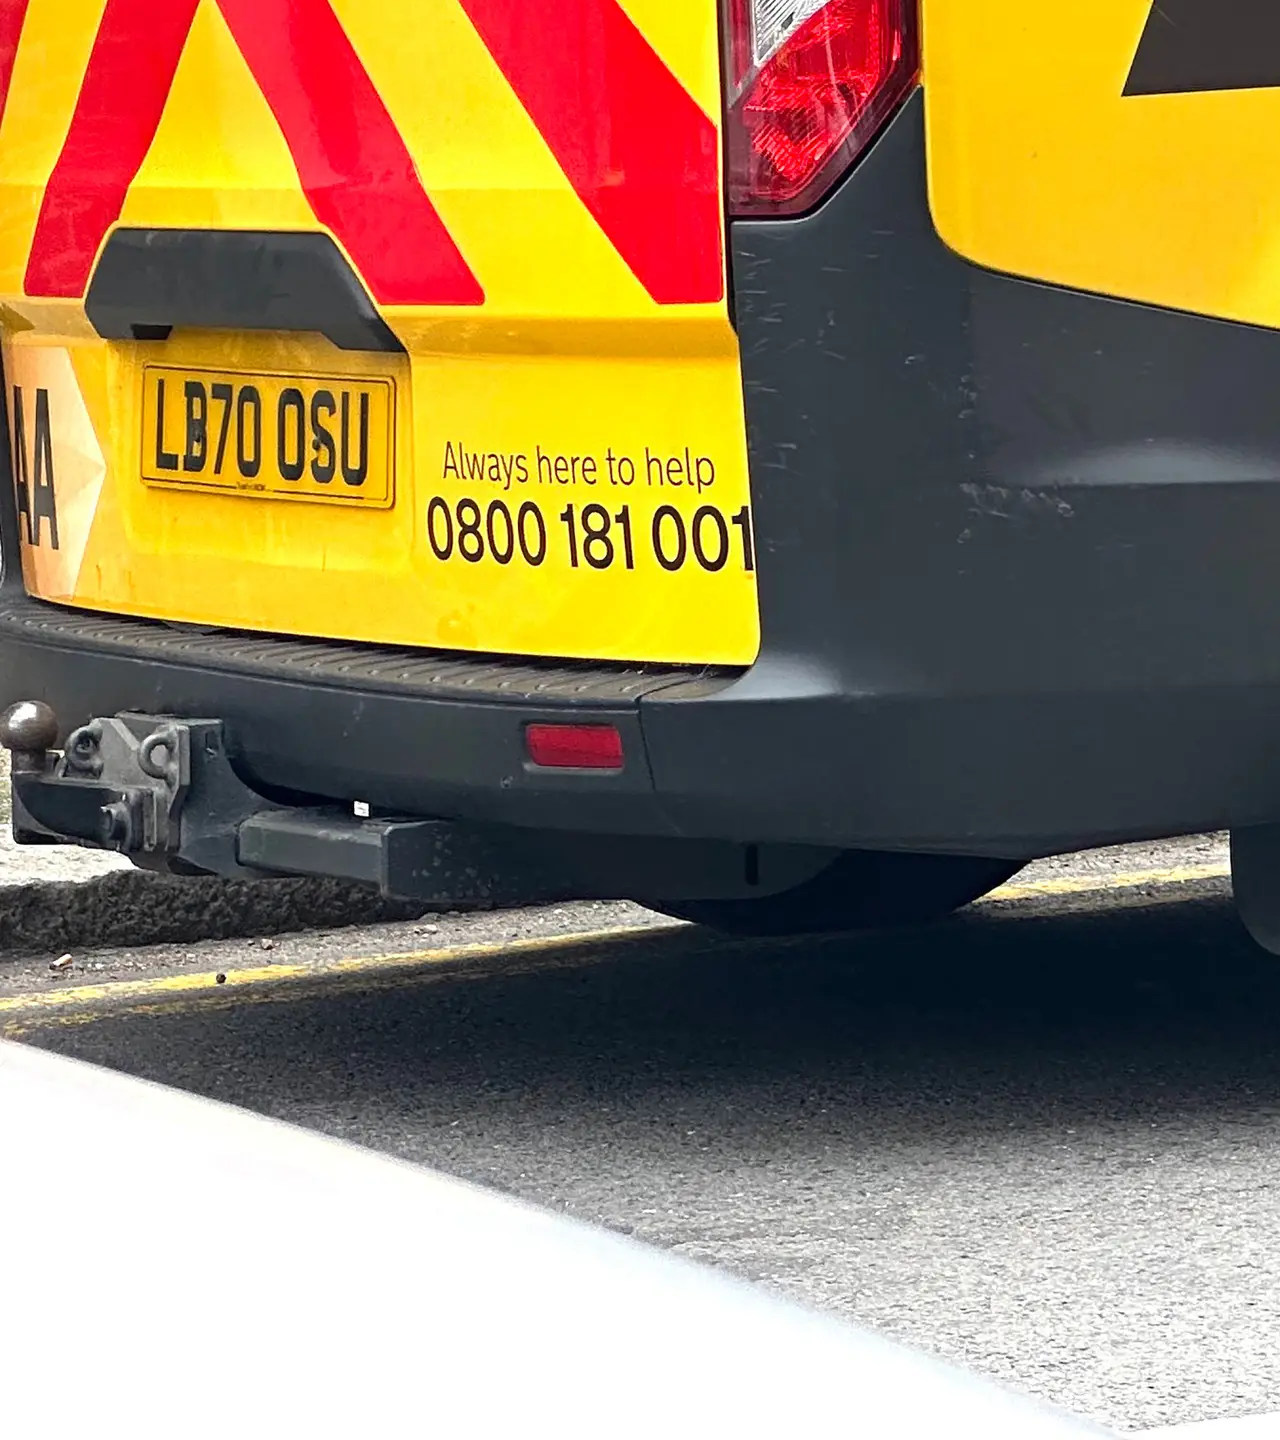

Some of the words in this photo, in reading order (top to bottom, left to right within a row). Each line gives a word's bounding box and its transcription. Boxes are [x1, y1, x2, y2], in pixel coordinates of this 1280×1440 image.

[155, 378, 262, 478] LB70
[276, 387, 369, 487] OSU
[442, 440, 530, 491] Always
[536, 444, 598, 486] here
[605, 447, 635, 487] to
[645, 446, 716, 495] help
[426, 495, 548, 568] 0800
[559, 502, 636, 571] 181
[651, 504, 756, 573] 001
